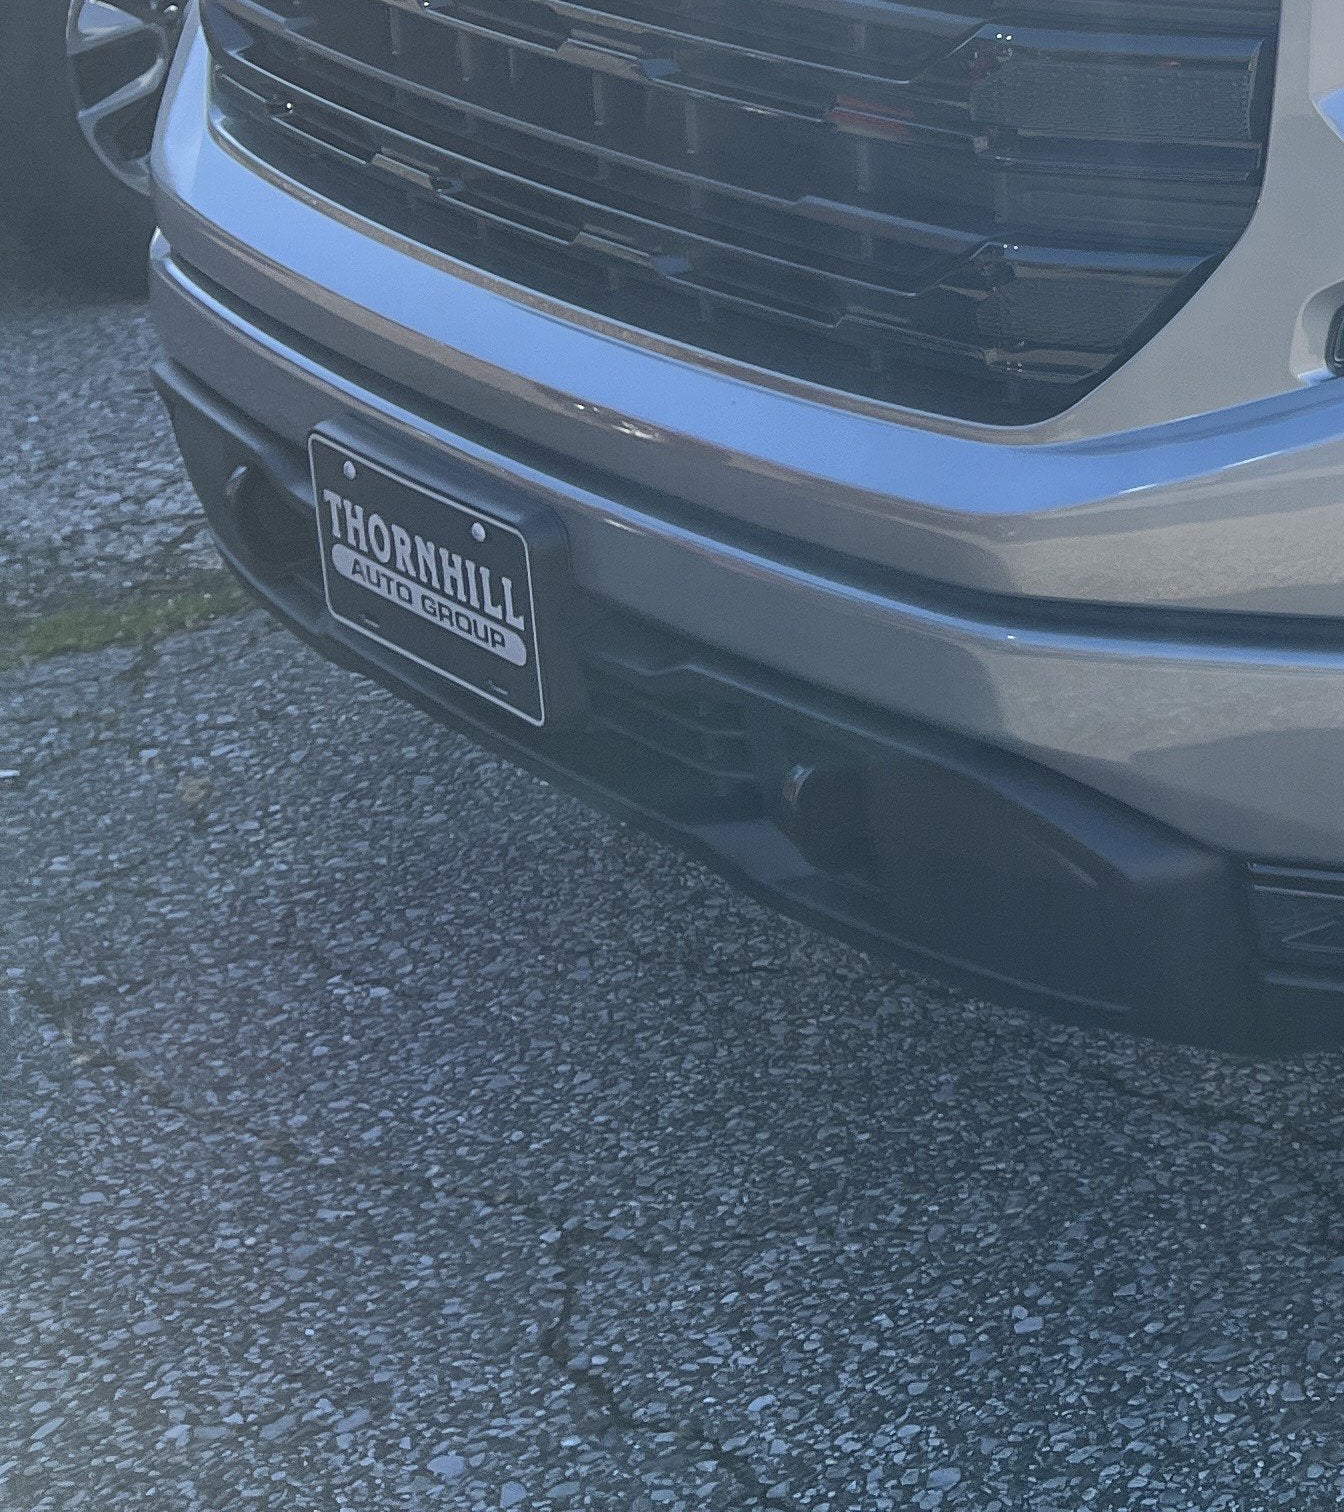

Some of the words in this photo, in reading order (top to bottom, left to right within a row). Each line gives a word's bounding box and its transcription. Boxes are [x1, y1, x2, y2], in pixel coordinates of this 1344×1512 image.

[322, 488, 526, 631] THORNHILL
[350, 556, 413, 605] AUTO
[420, 592, 507, 649] GROUP
